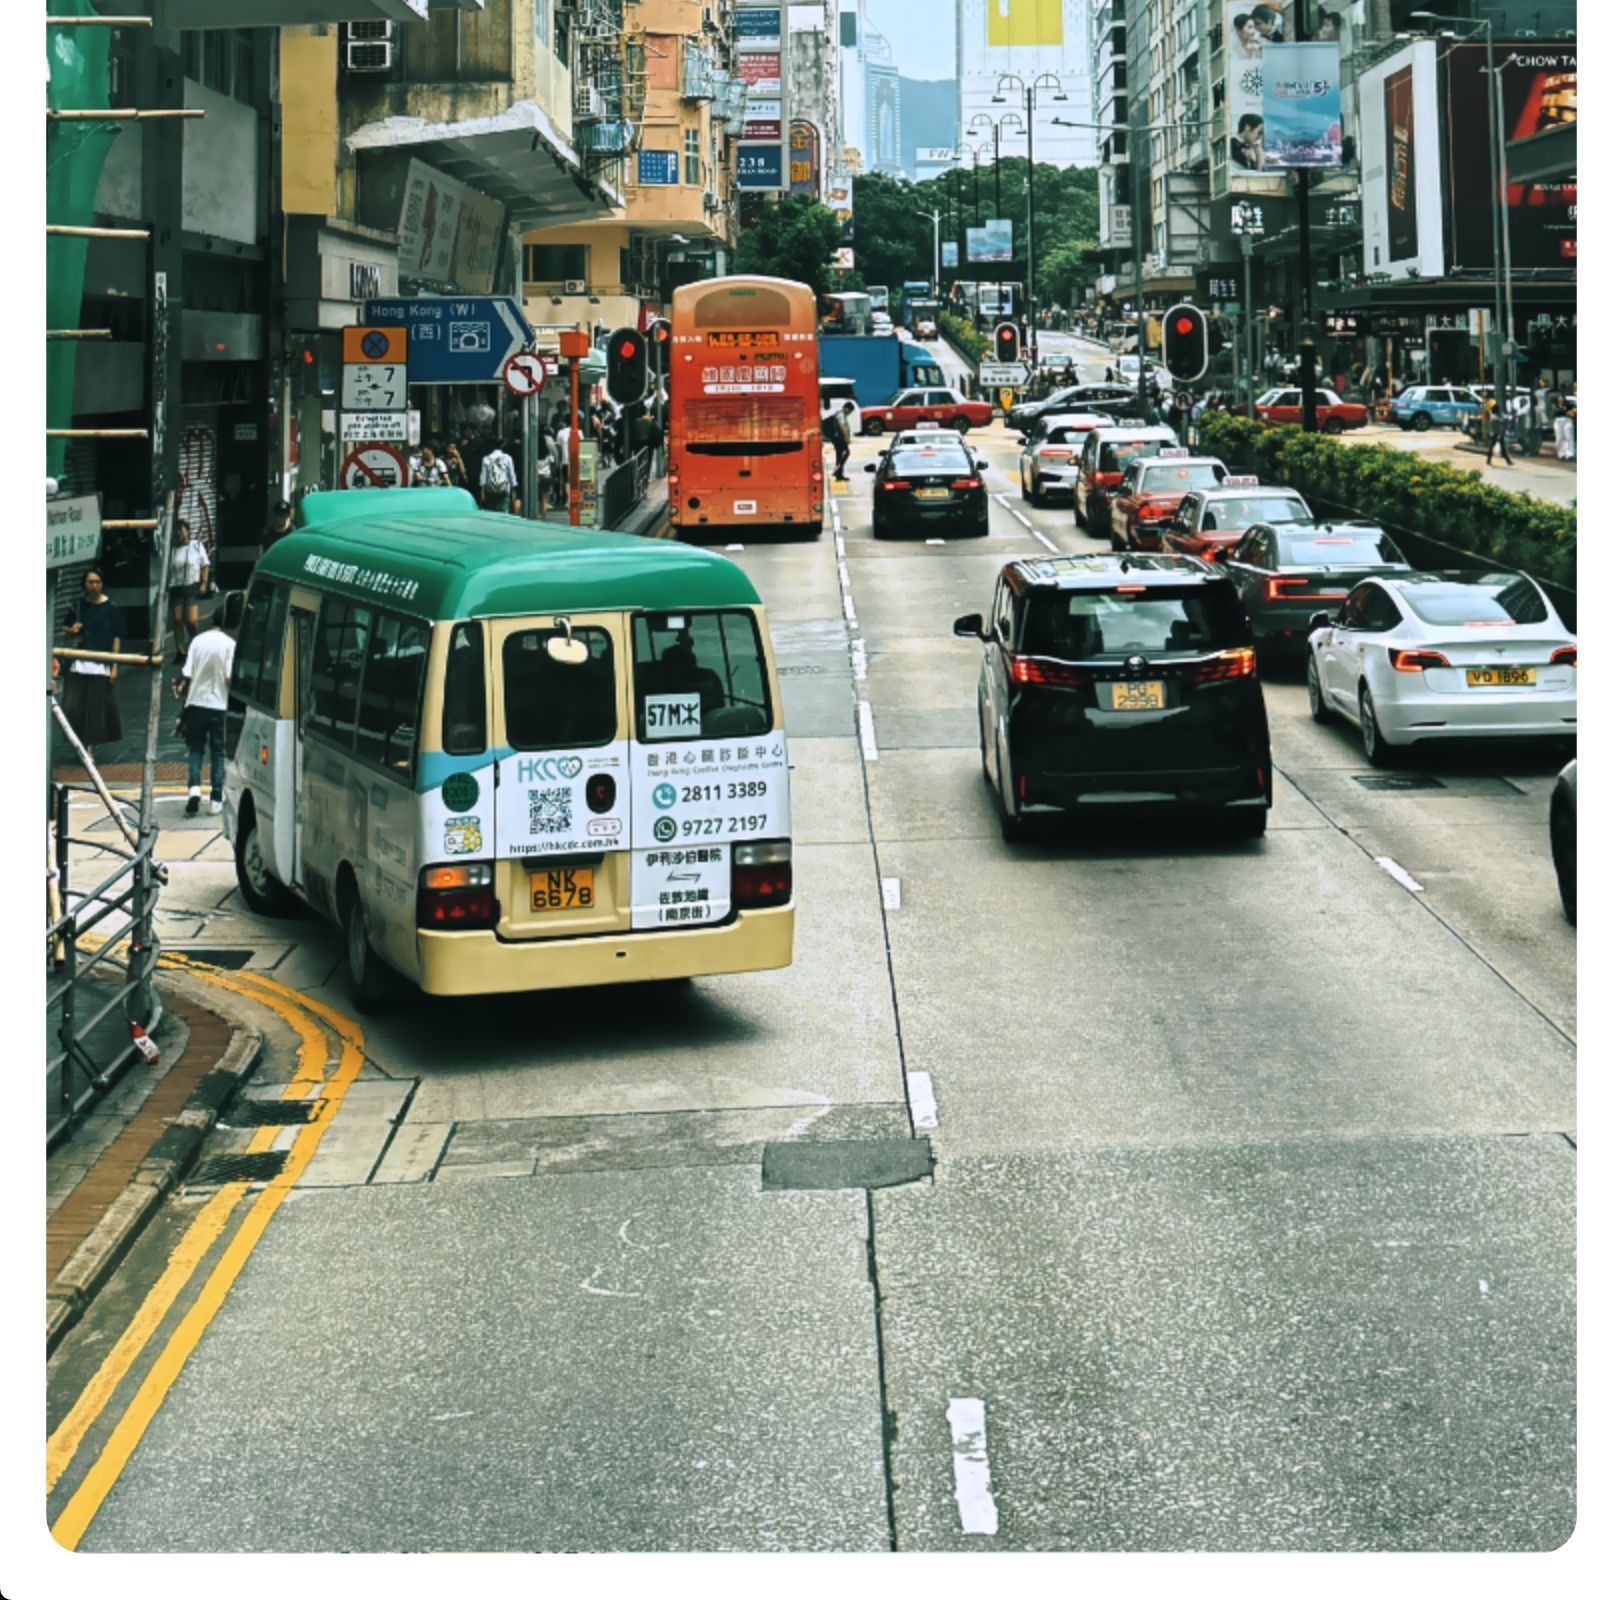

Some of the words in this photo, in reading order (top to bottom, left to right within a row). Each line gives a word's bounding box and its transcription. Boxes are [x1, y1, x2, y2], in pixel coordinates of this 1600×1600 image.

[371, 304, 405, 318] Hong
[409, 304, 443, 319] Kong
[384, 368, 395, 383] 7
[384, 392, 395, 407] 7
[1473, 672, 1492, 683] VD
[647, 703, 681, 727] 57M
[681, 784, 721, 802] 2811
[727, 781, 767, 799] 3389
[682, 818, 723, 836] 9727
[728, 814, 768, 832] 2197
[646, 848, 723, 867] 伊利沙伯醫院
[547, 869, 577, 892] NK
[533, 887, 592, 908] 6678
